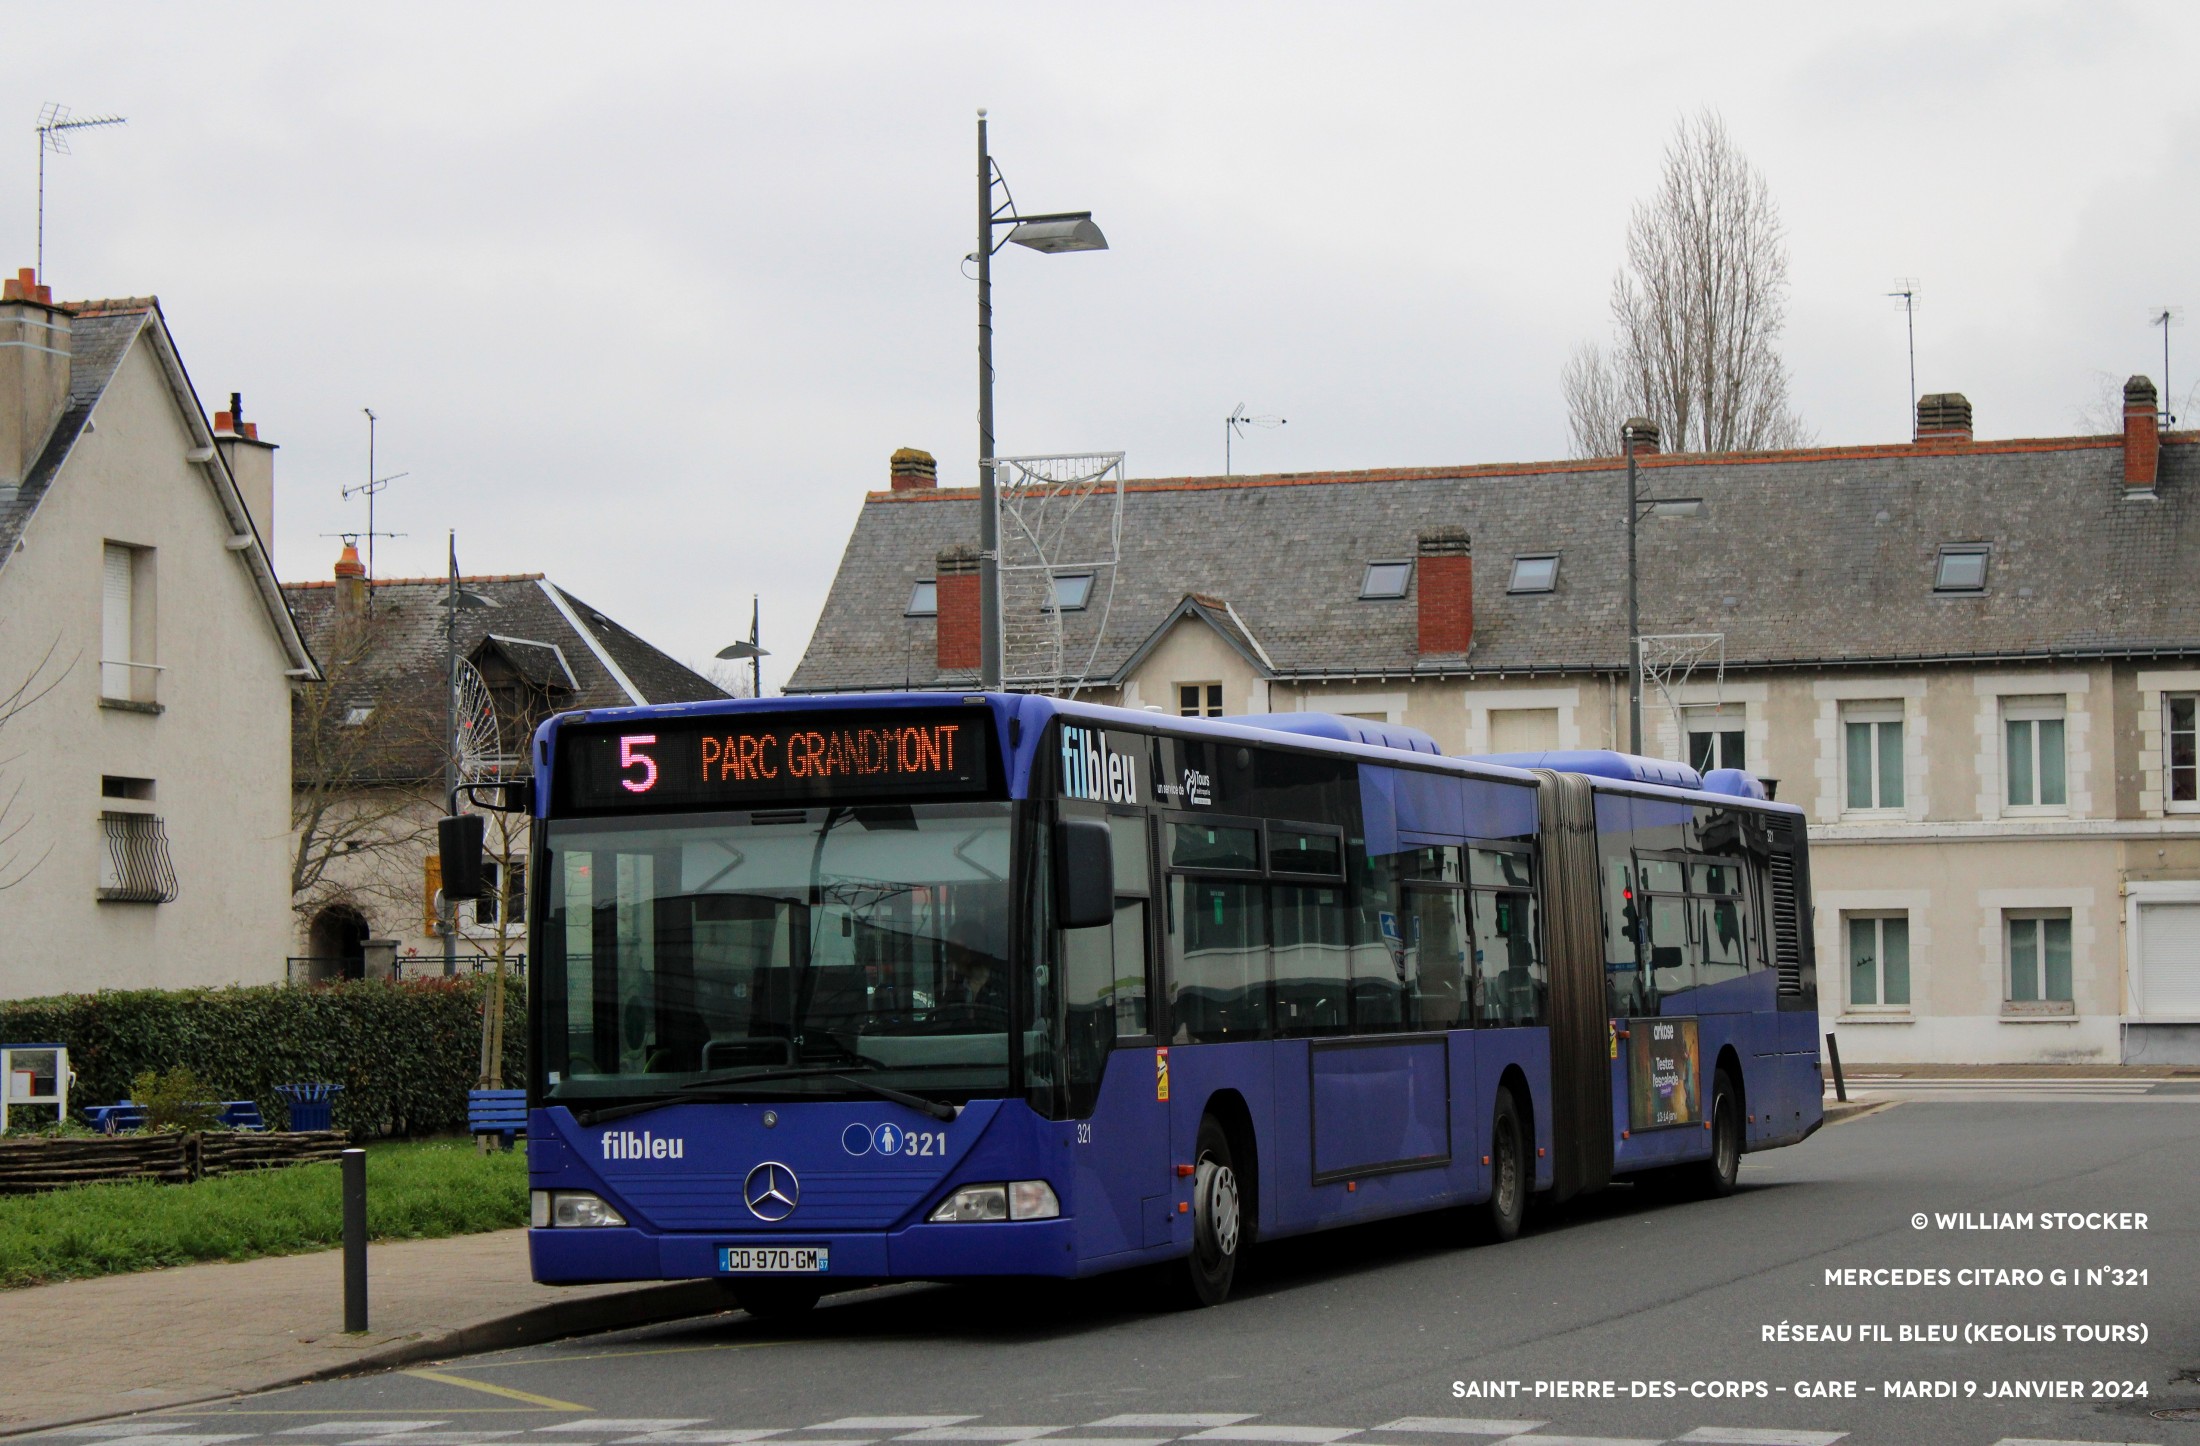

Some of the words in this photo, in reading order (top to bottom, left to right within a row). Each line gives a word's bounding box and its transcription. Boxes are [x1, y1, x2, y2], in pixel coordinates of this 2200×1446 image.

[620, 735, 658, 792] 5
[702, 734, 778, 782] PARC
[787, 725, 959, 778] GRANDMONT
[1062, 725, 1137, 804] filbleu
[1164, 783, 1178, 795] service
[1654, 1022, 1673, 1040] arkose
[1656, 1057, 1674, 1070] Testez
[904, 1132, 946, 1156] 321
[1077, 1123, 1091, 1144] 321
[601, 1132, 683, 1160] filbleu
[729, 1250, 818, 1269] CD-970-GM
